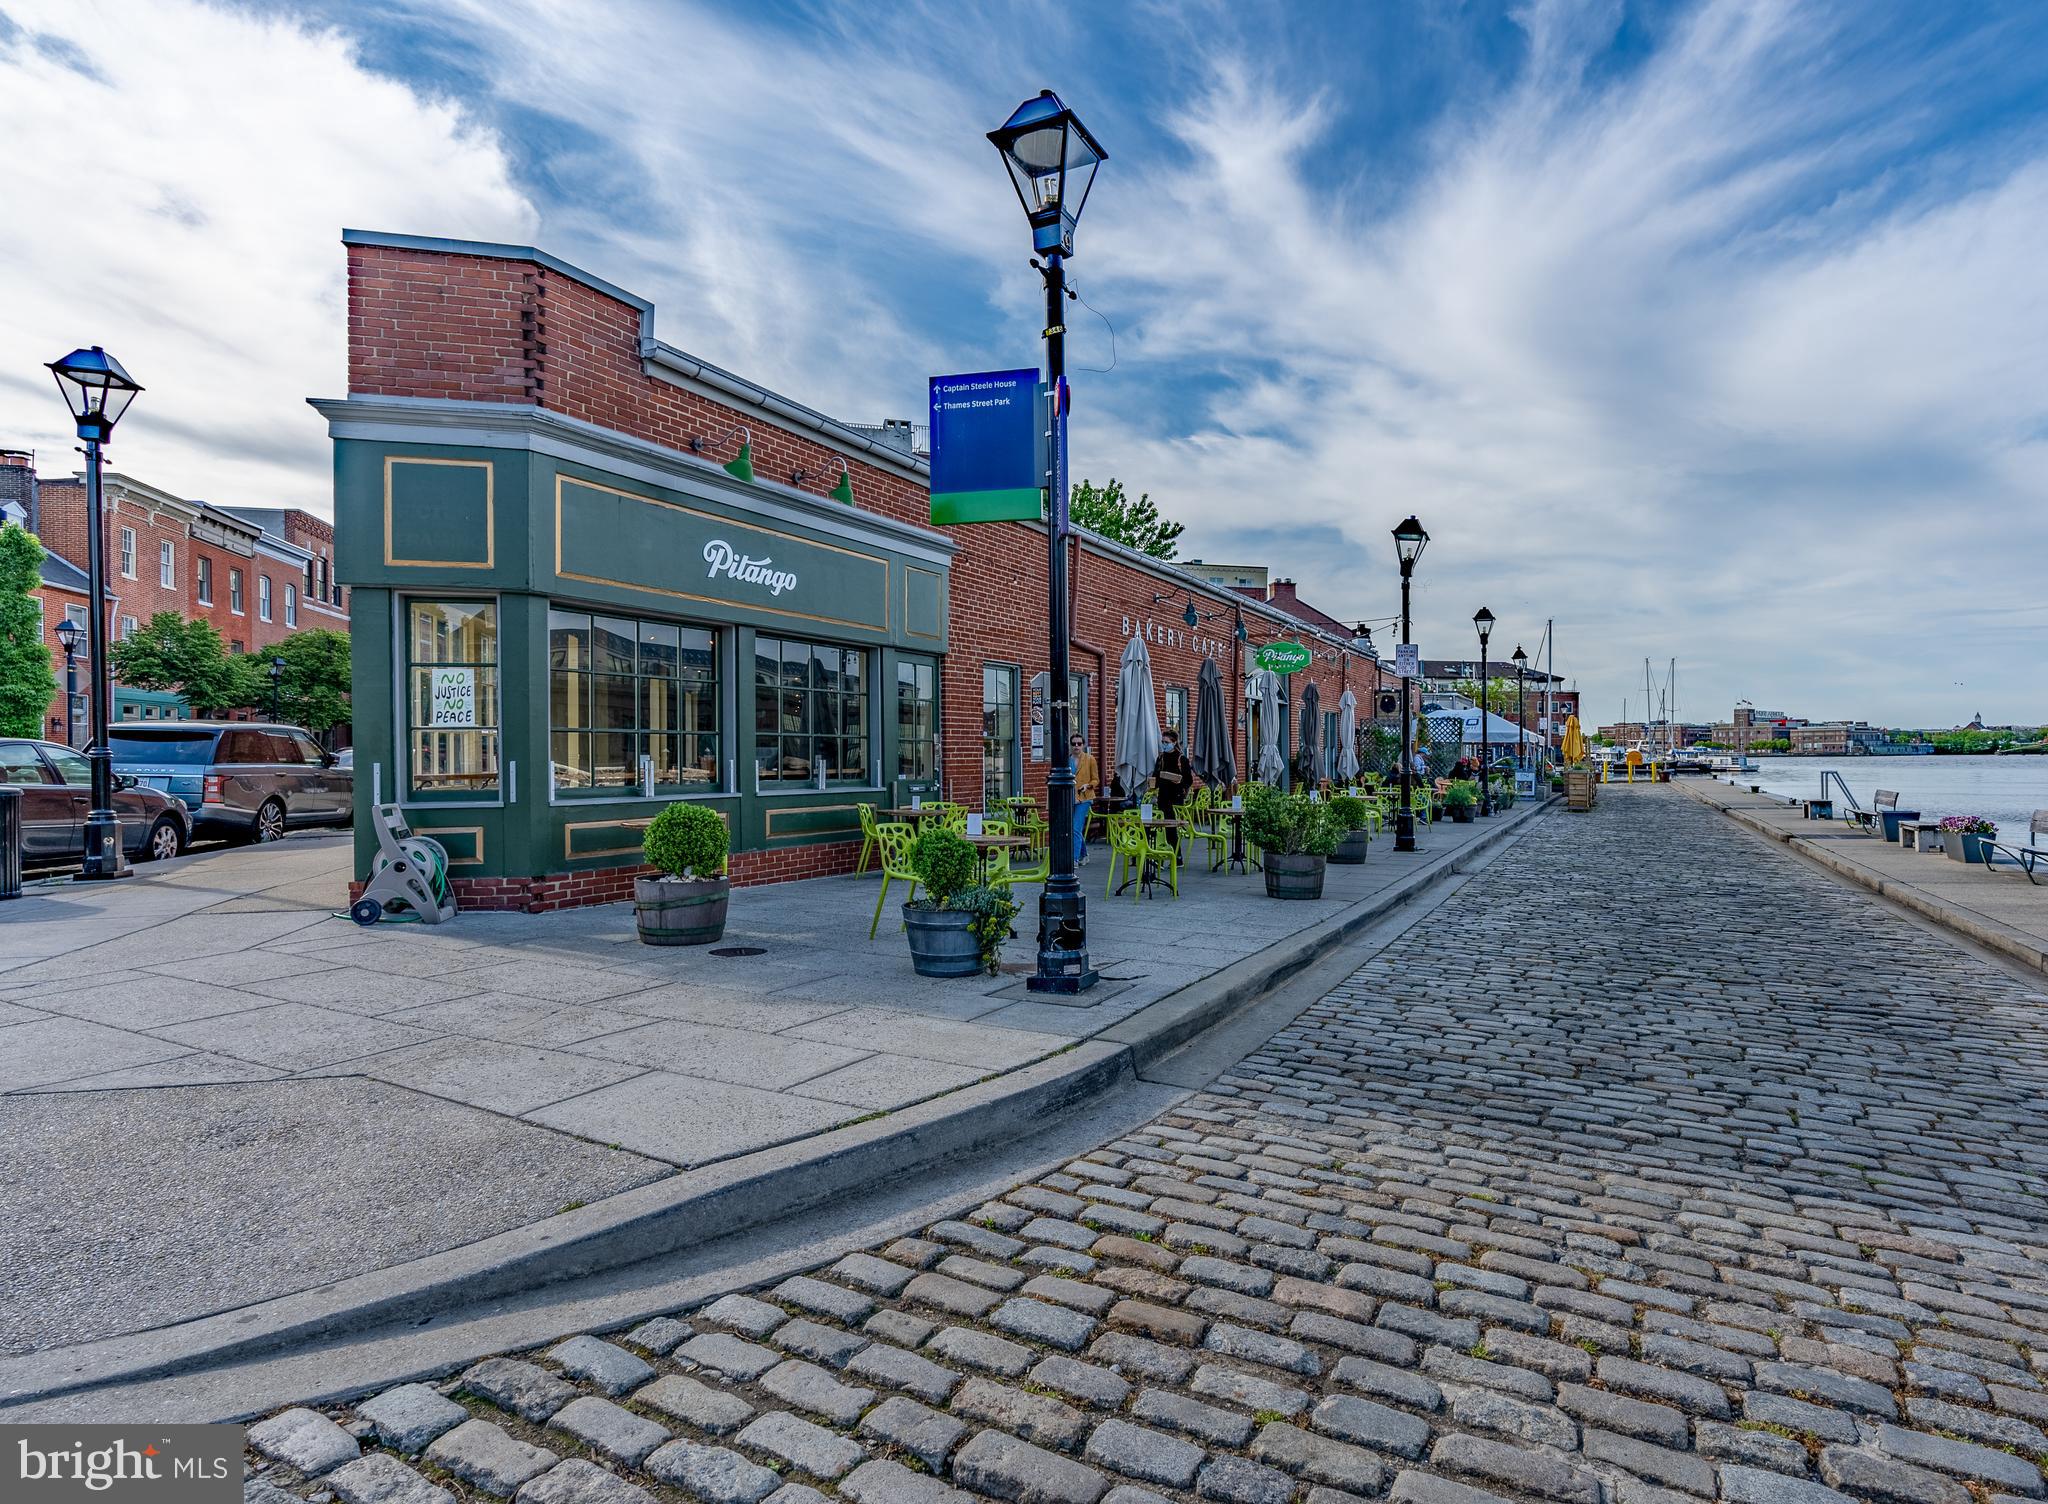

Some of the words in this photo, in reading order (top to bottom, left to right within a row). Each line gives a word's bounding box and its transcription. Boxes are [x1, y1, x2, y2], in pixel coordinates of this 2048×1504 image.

[943, 383, 970, 393] Captain
[970, 381, 993, 390] Steele
[994, 380, 1017, 388] House
[943, 402, 971, 410] Thames
[971, 399, 993, 407] Street
[994, 397, 1011, 405] Park
[703, 539, 797, 596] Pitango
[1122, 616, 1184, 649] BAKERY
[1263, 649, 1305, 664] Pitango
[441, 672, 465, 685] NO
[435, 685, 472, 700] JUSTICE
[443, 698, 464, 710] NO
[435, 710, 472, 723] PEACE
